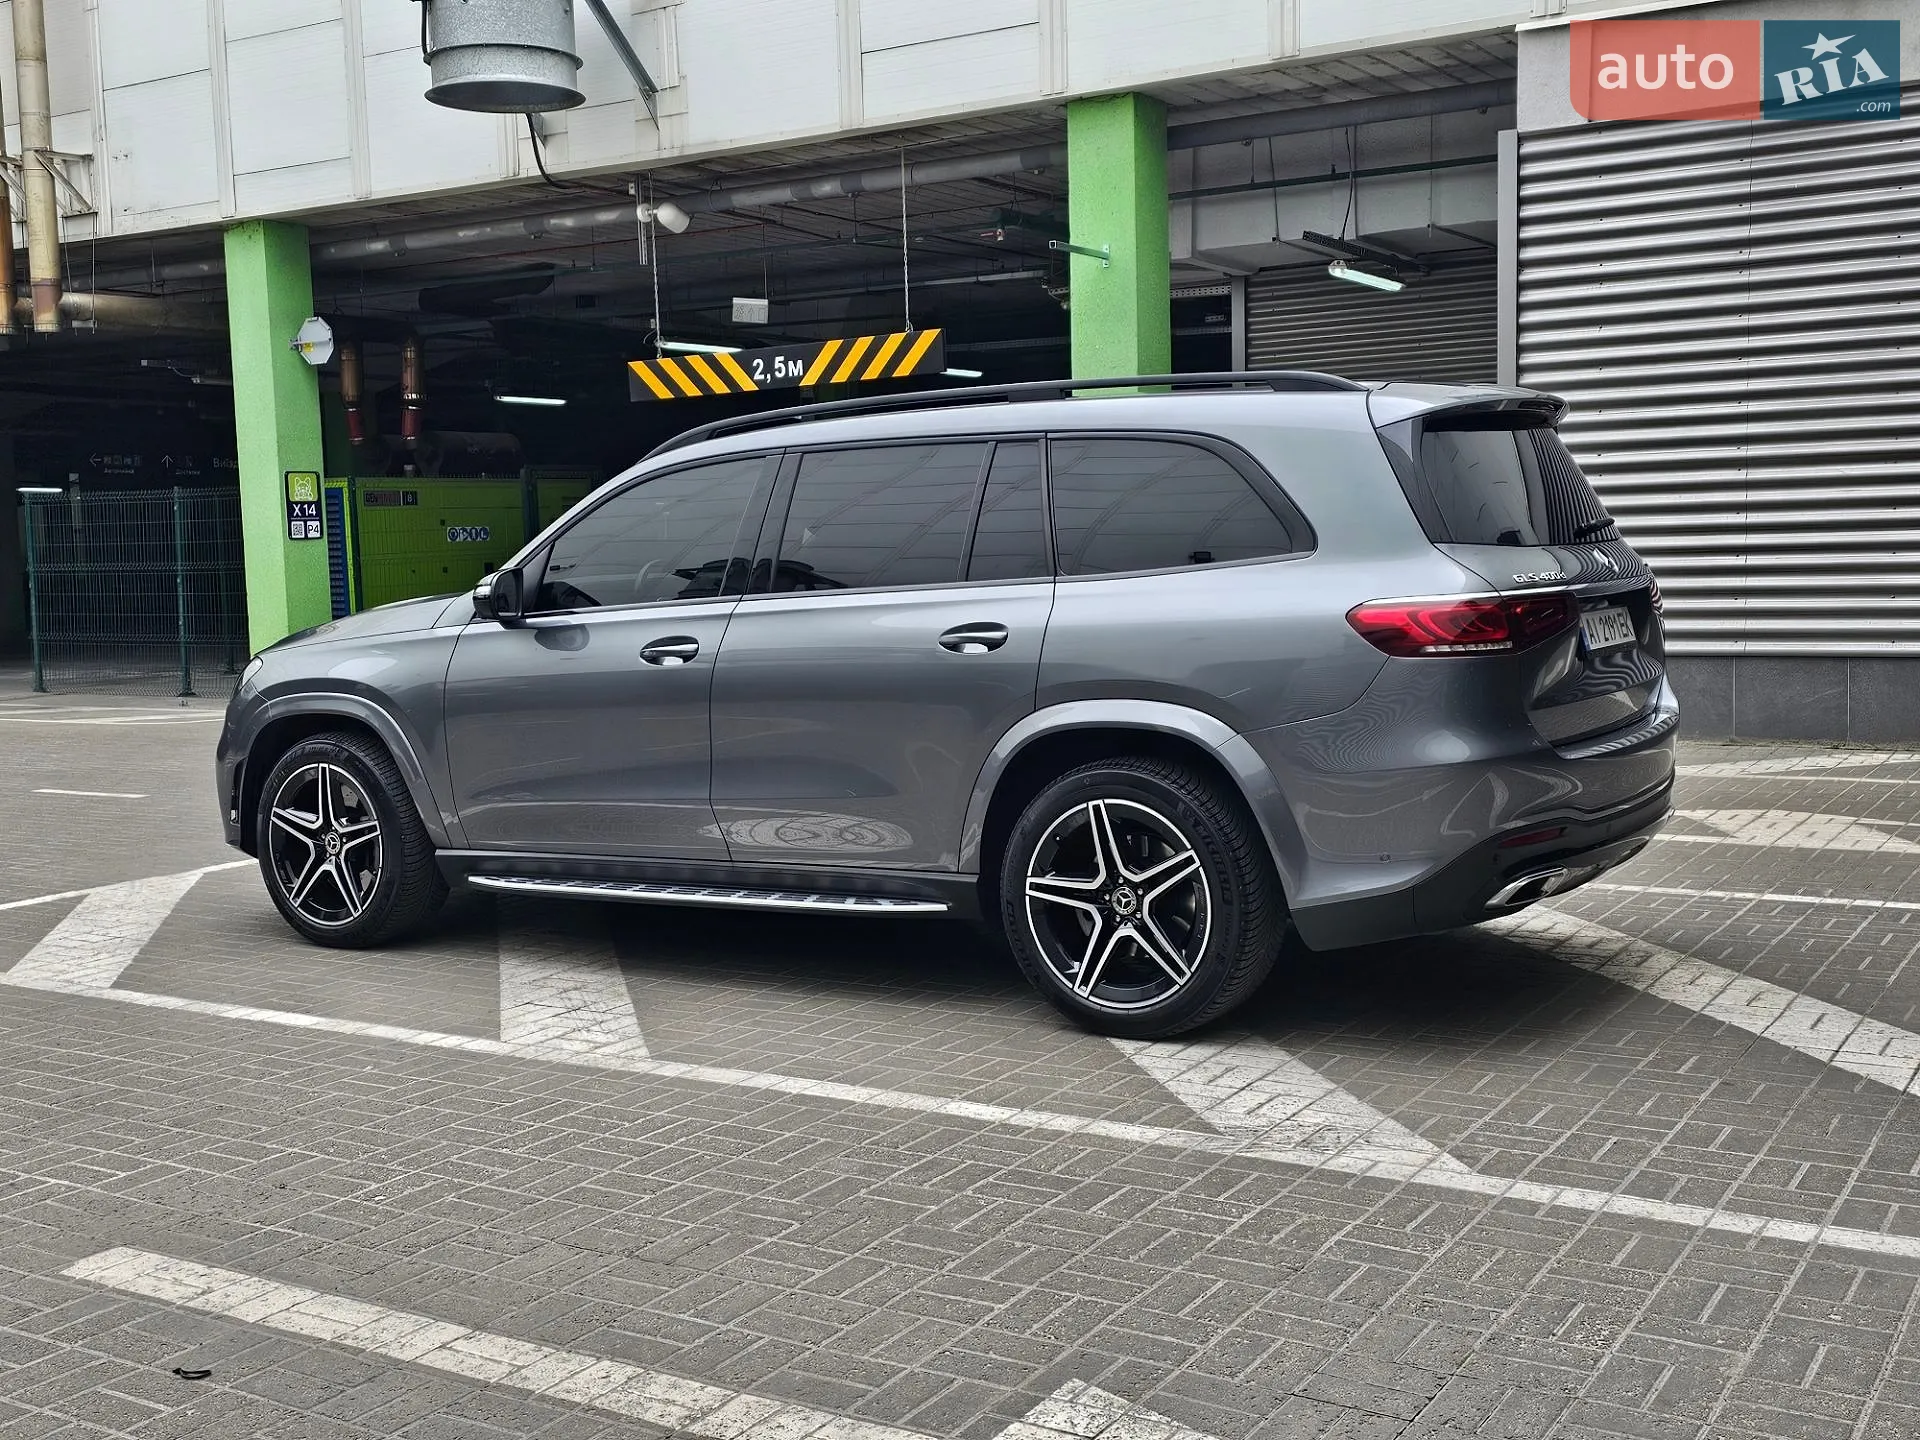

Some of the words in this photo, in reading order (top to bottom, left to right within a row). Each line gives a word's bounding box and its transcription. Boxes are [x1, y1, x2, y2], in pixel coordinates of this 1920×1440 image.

[752, 355, 804, 383] 2,5м
[307, 524, 319, 534] P4
[1512, 572, 1539, 583] GLS
[1539, 571, 1567, 581] 400d
